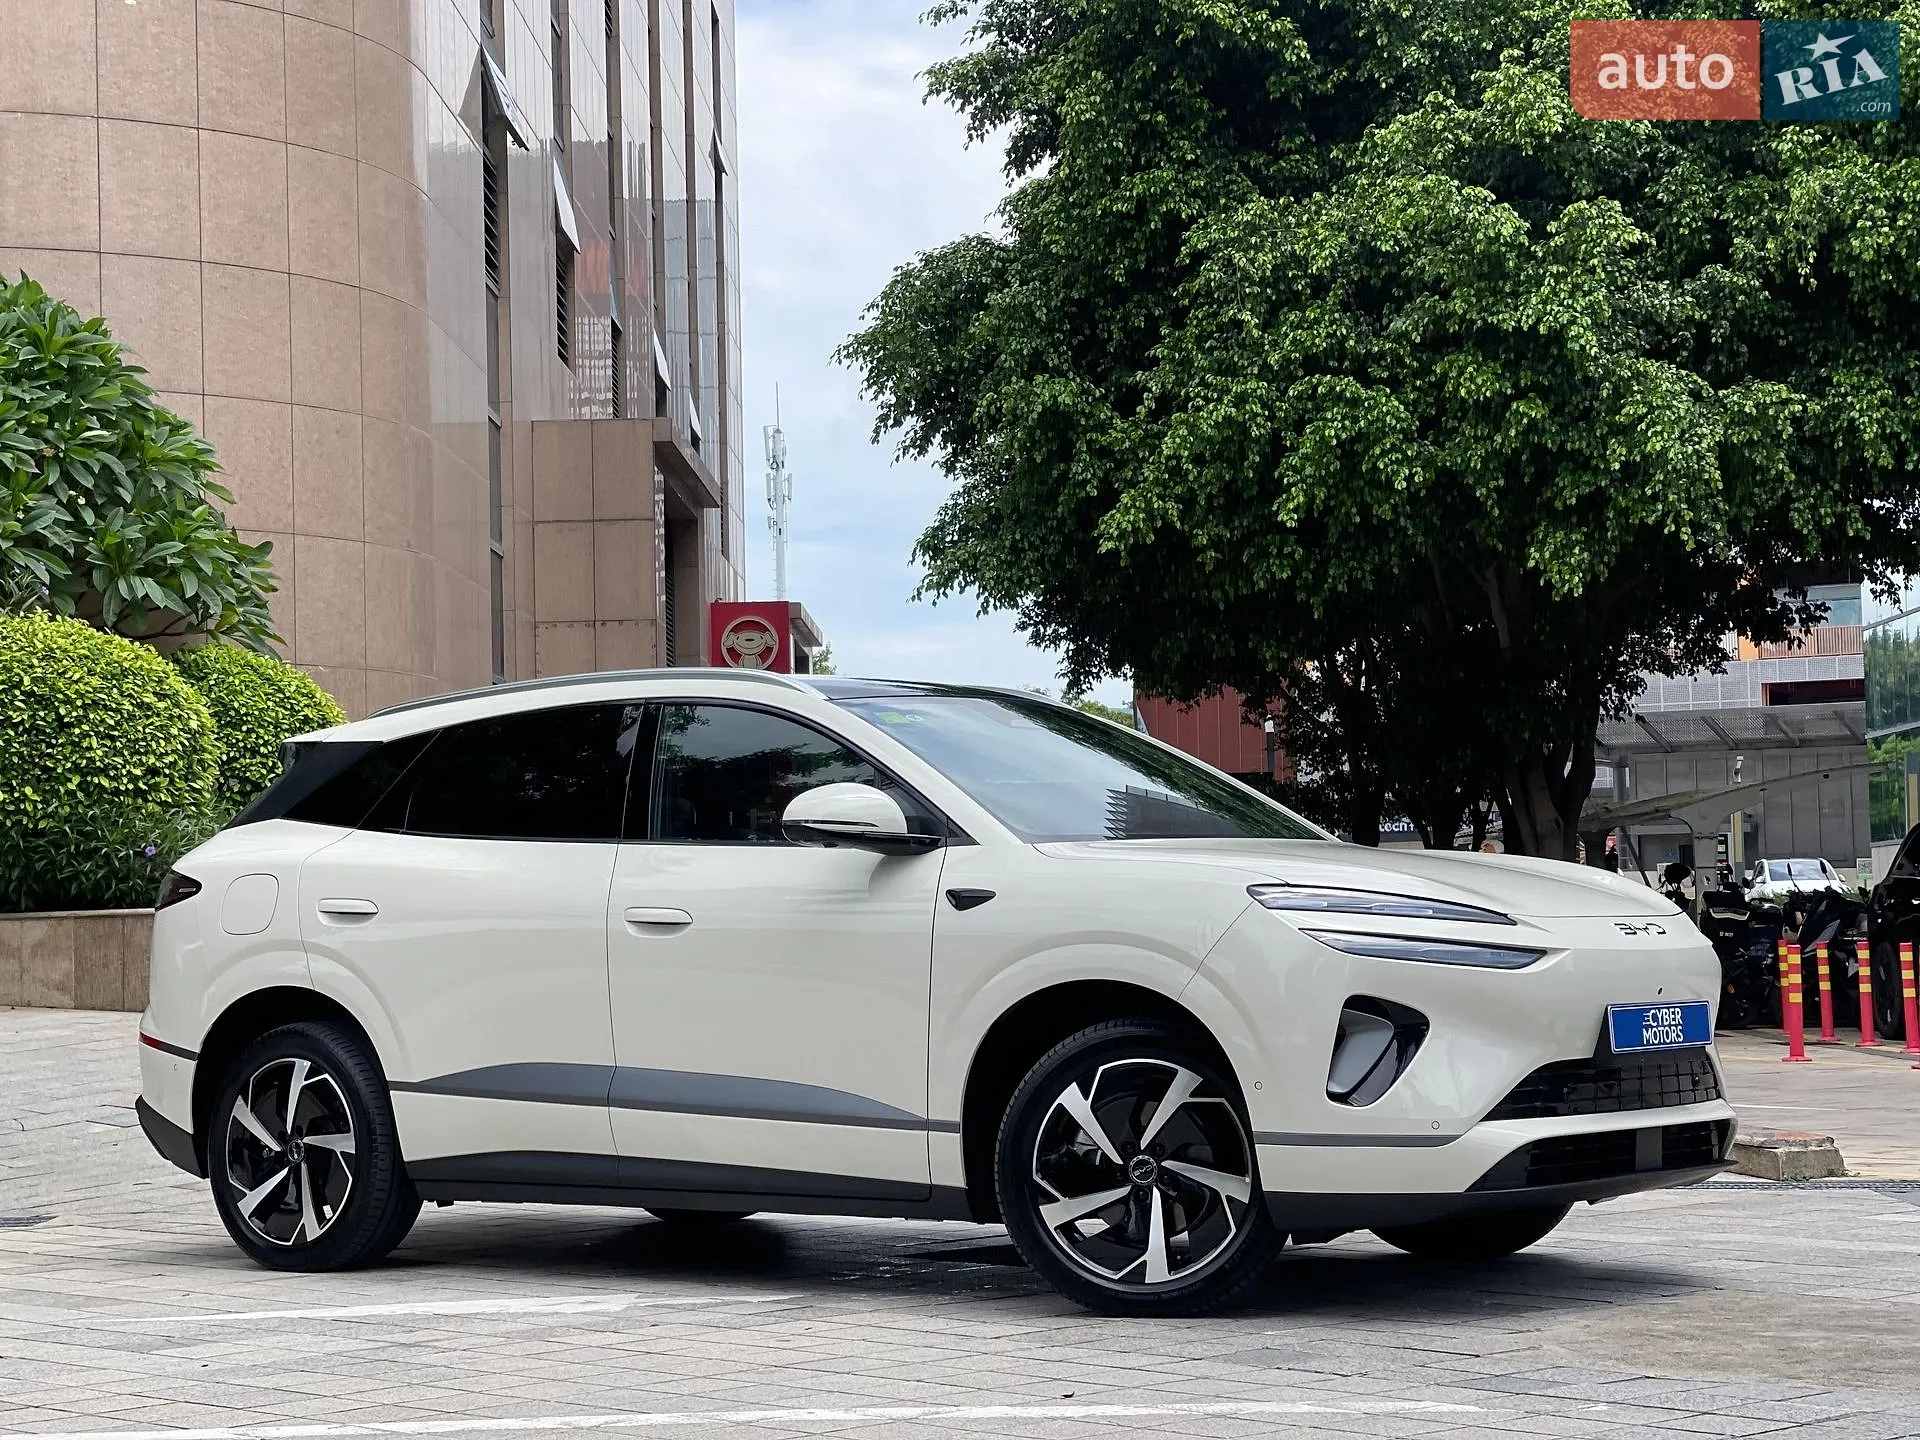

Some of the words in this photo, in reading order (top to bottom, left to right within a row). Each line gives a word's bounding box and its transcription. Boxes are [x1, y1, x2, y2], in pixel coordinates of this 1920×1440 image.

[1610, 922, 1667, 936] BYD
[1648, 1007, 1683, 1027] CYBER
[1642, 1025, 1684, 1045] MOTORS
